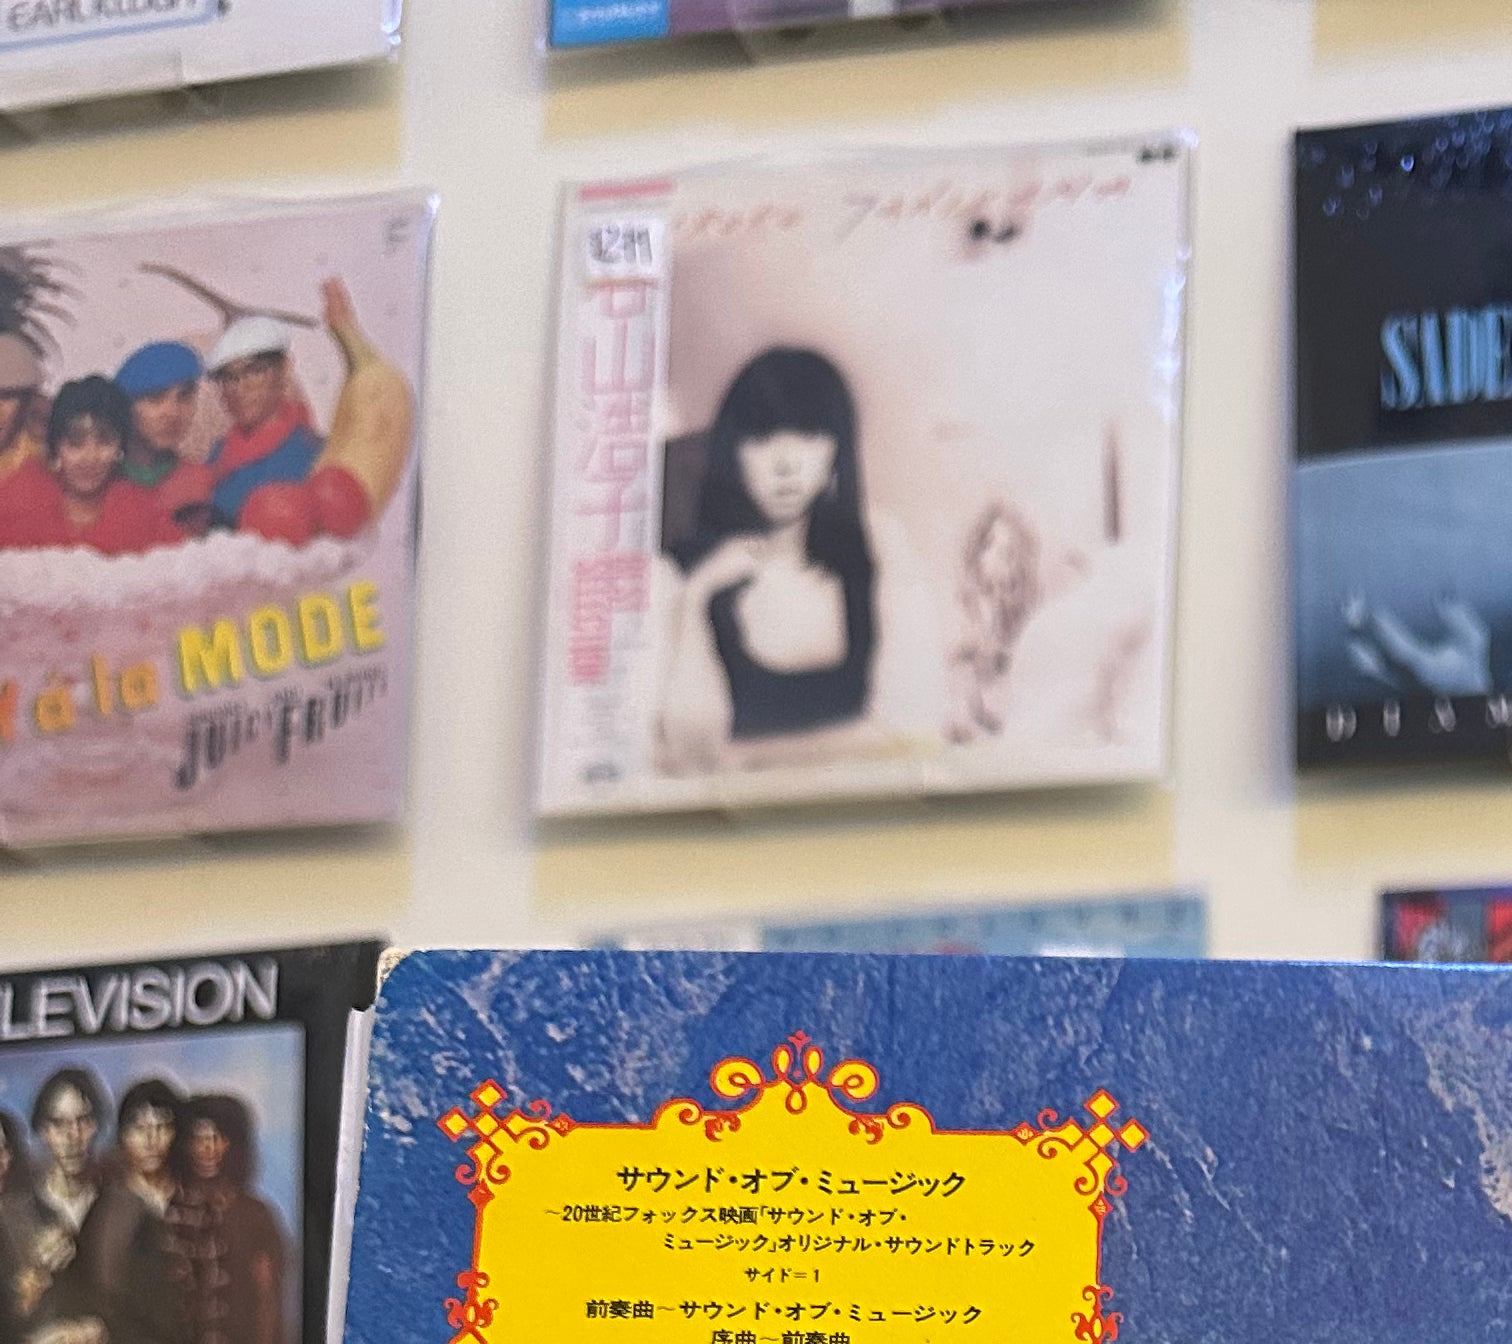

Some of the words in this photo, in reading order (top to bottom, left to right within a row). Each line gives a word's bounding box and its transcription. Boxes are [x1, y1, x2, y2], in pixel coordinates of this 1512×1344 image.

[175, 580, 387, 698] MODE
[617, 1166, 967, 1197] サウンド・オブ・ミュージック
